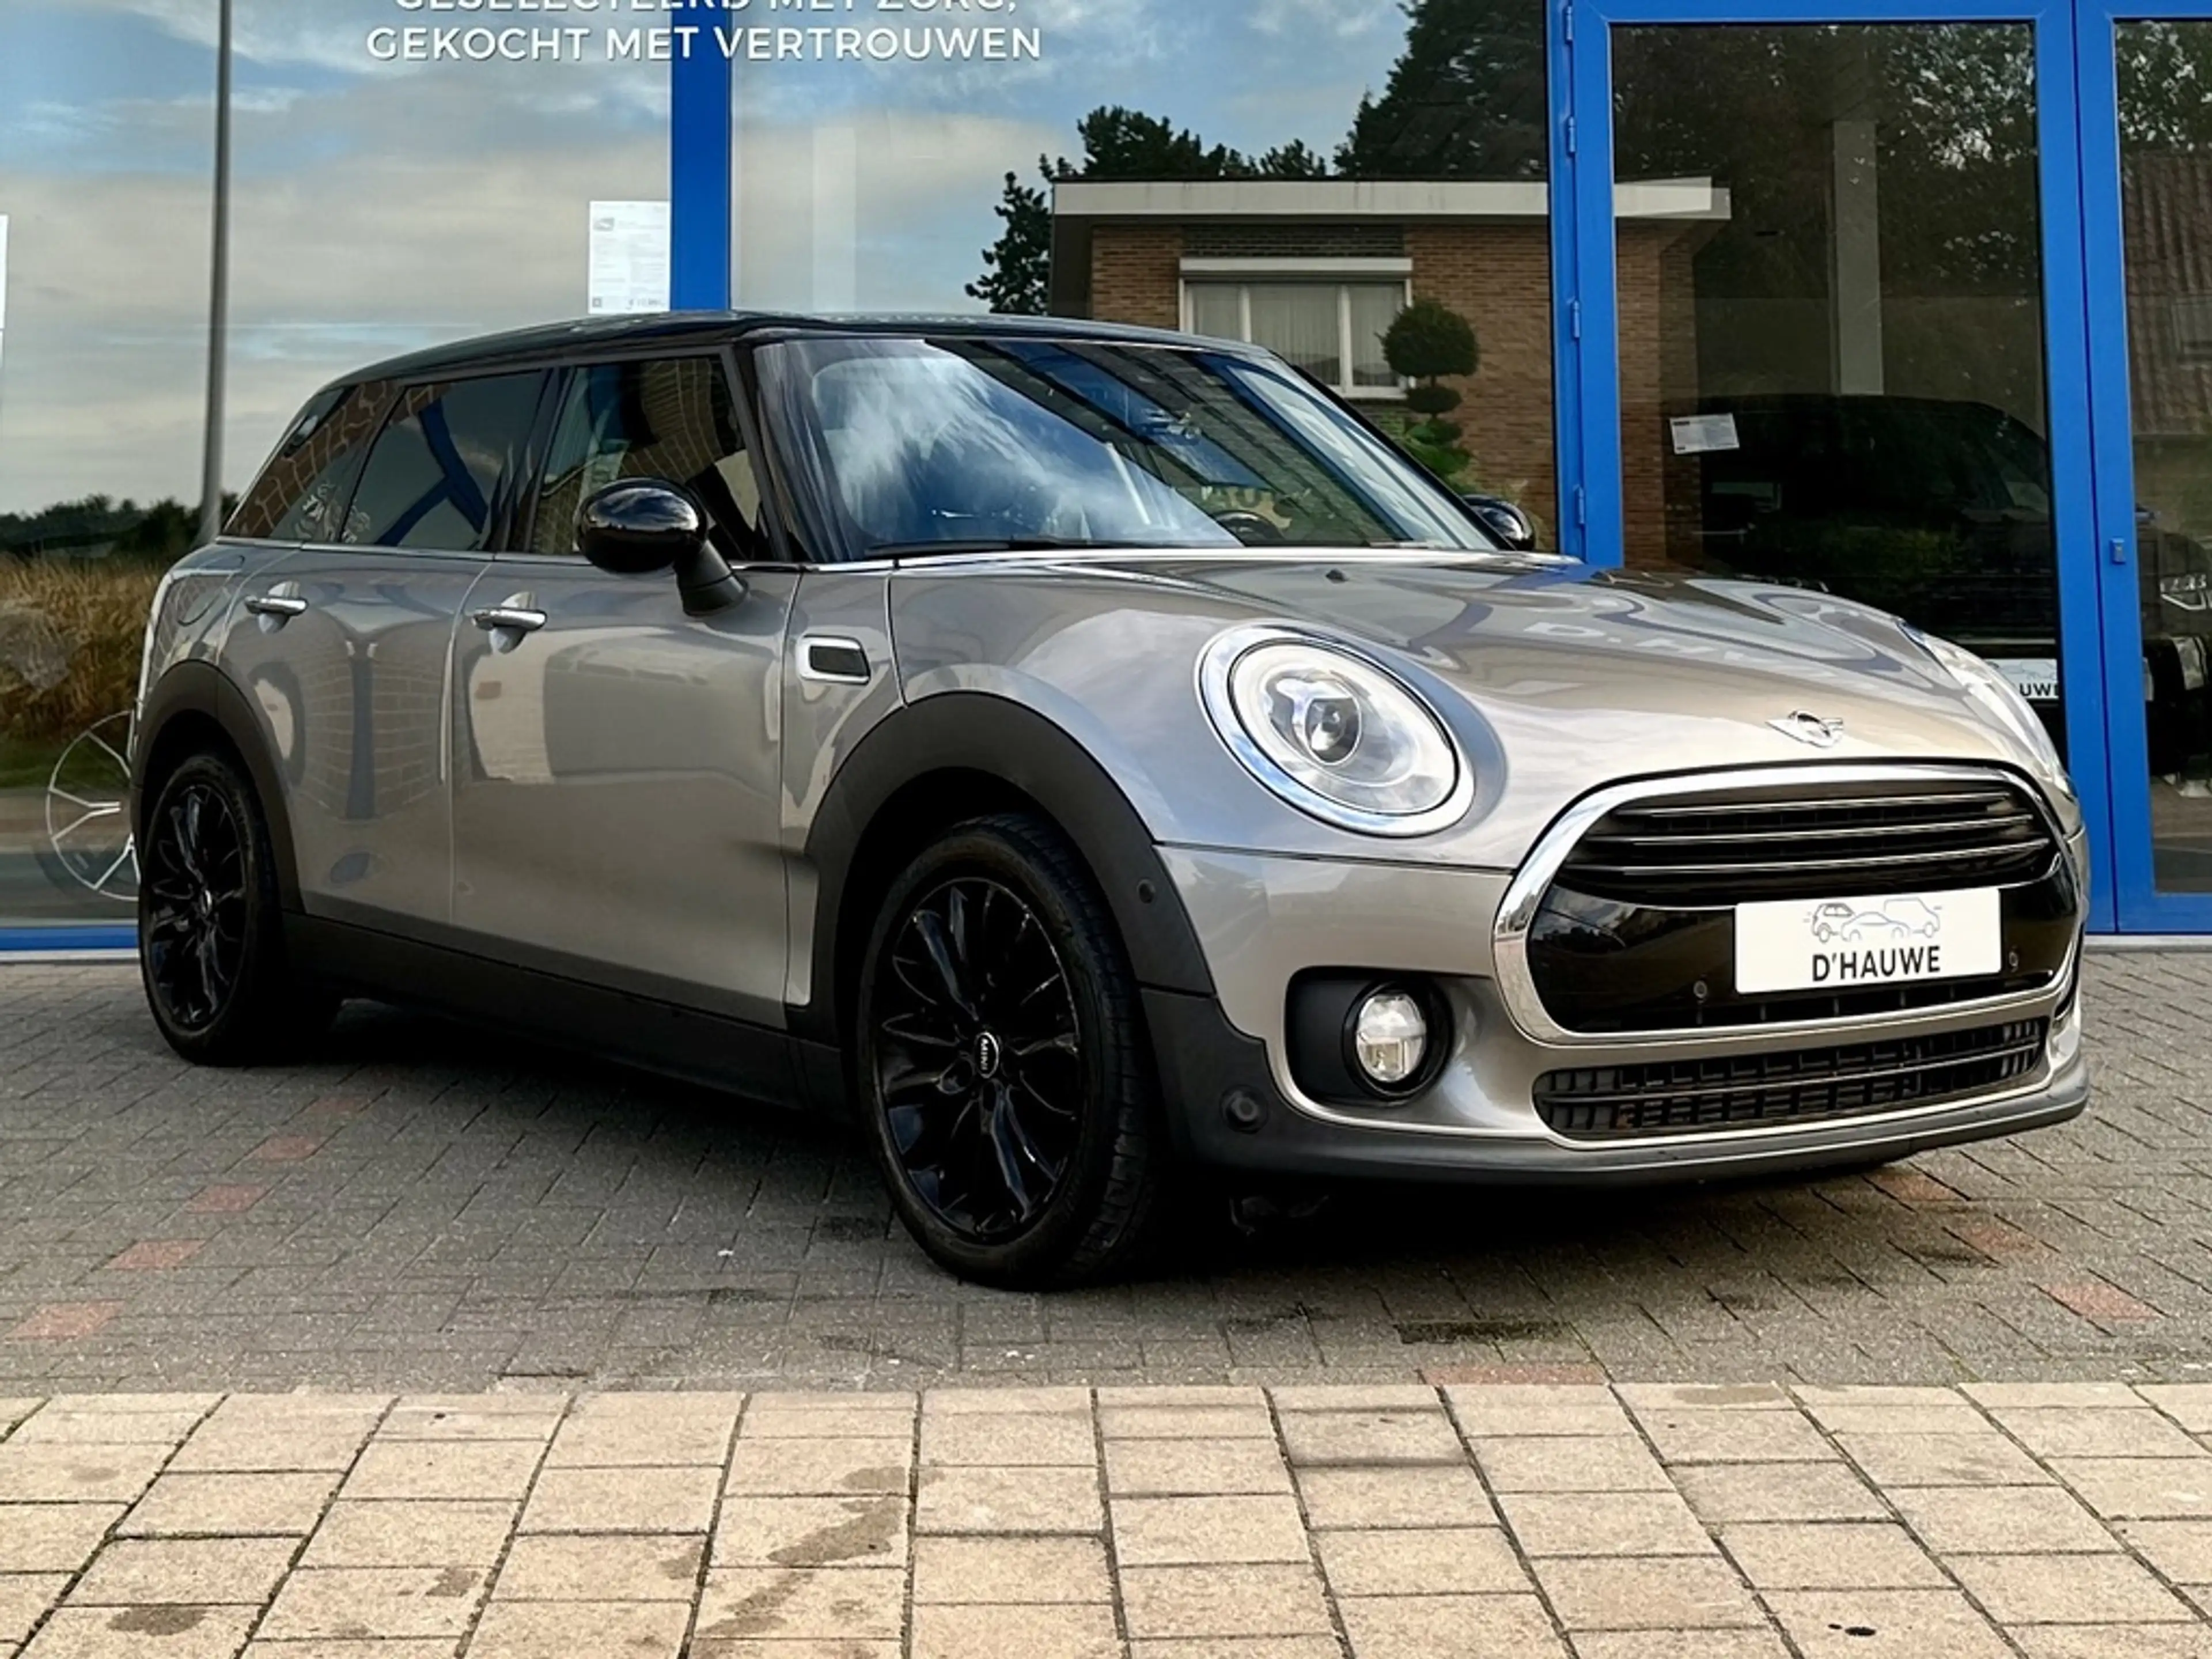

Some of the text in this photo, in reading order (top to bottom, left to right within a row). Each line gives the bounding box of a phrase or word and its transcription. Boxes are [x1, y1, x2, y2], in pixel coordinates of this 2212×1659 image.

[366, 26, 1041, 59] GEKOCHT MET VERTROUWEN
[1812, 945, 1941, 982] D'HAUWE
